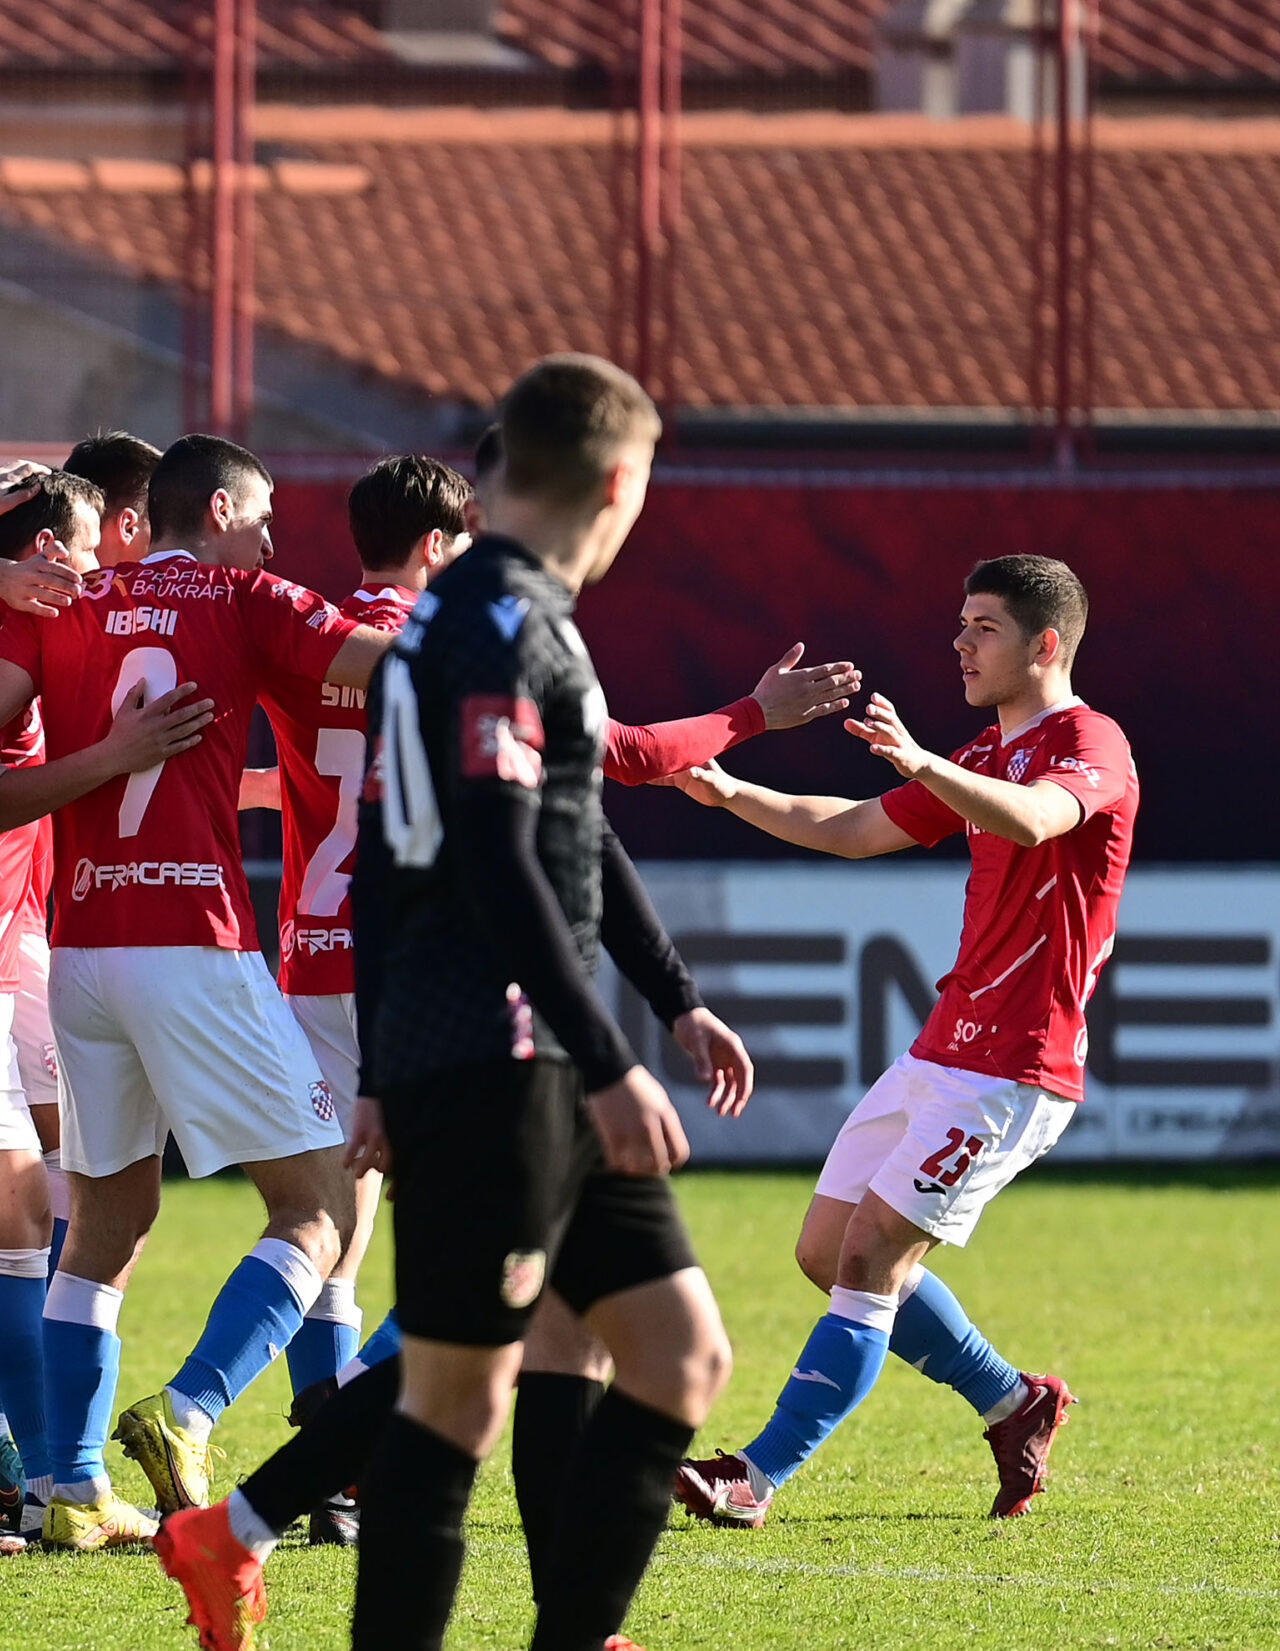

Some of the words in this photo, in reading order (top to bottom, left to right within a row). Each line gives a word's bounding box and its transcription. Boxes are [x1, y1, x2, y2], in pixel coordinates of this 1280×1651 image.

[131, 580, 235, 604] BAUKRAFT
[105, 606, 178, 636] IBISHI
[111, 646, 178, 839] 9
[296, 927, 354, 957] FRA
